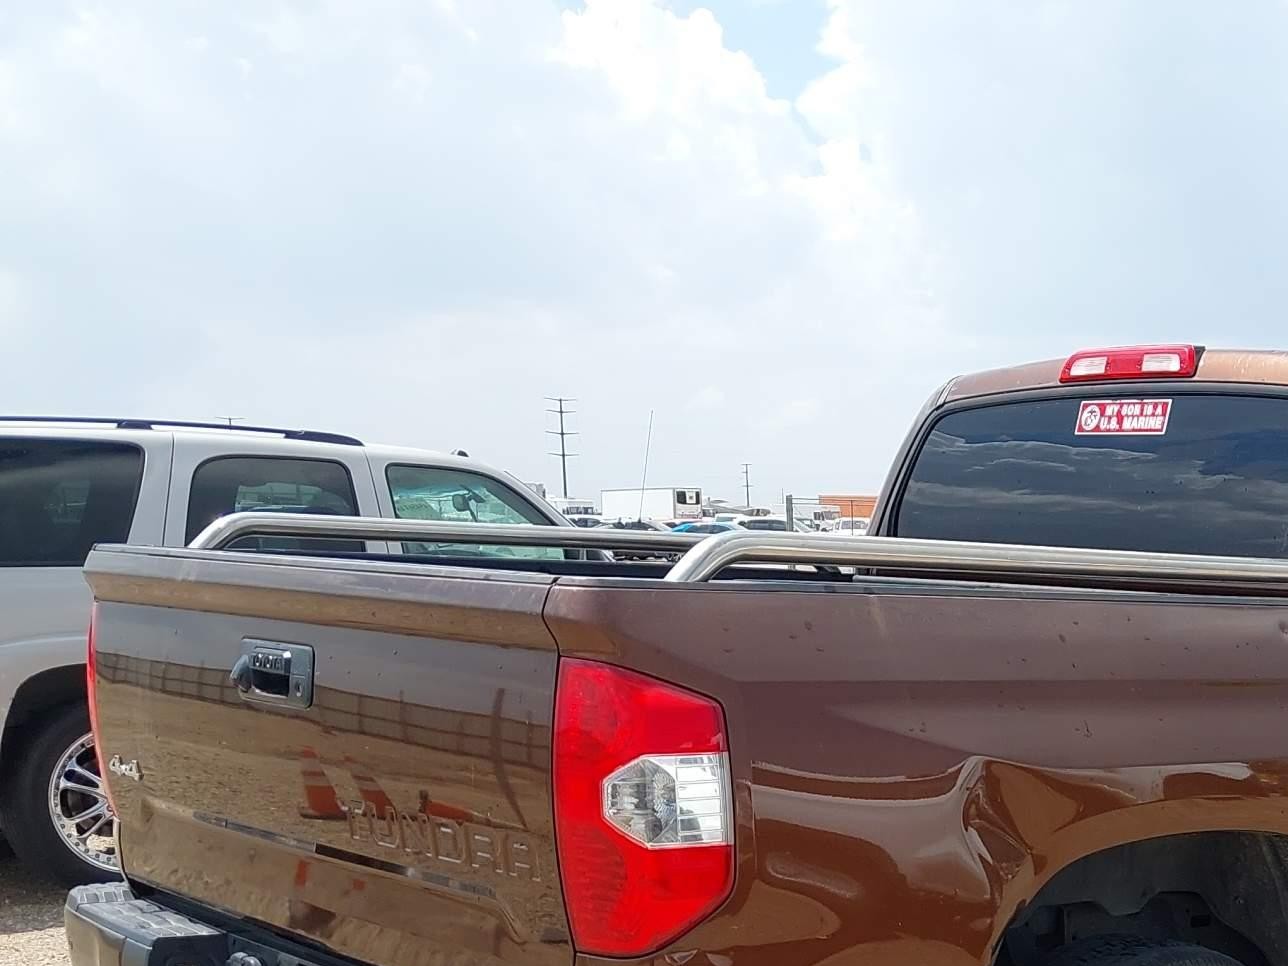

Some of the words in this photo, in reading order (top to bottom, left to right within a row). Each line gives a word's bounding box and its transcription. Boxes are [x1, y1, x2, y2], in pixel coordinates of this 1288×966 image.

[1104, 404, 1120, 416] MY
[1121, 404, 1140, 416] SON
[1142, 403, 1153, 416] IS
[1154, 403, 1163, 415] A
[1100, 416, 1119, 430] U.S.
[1122, 416, 1163, 430] MARINE
[109, 754, 141, 780] 4x4
[337, 800, 542, 882] TUNDRA
